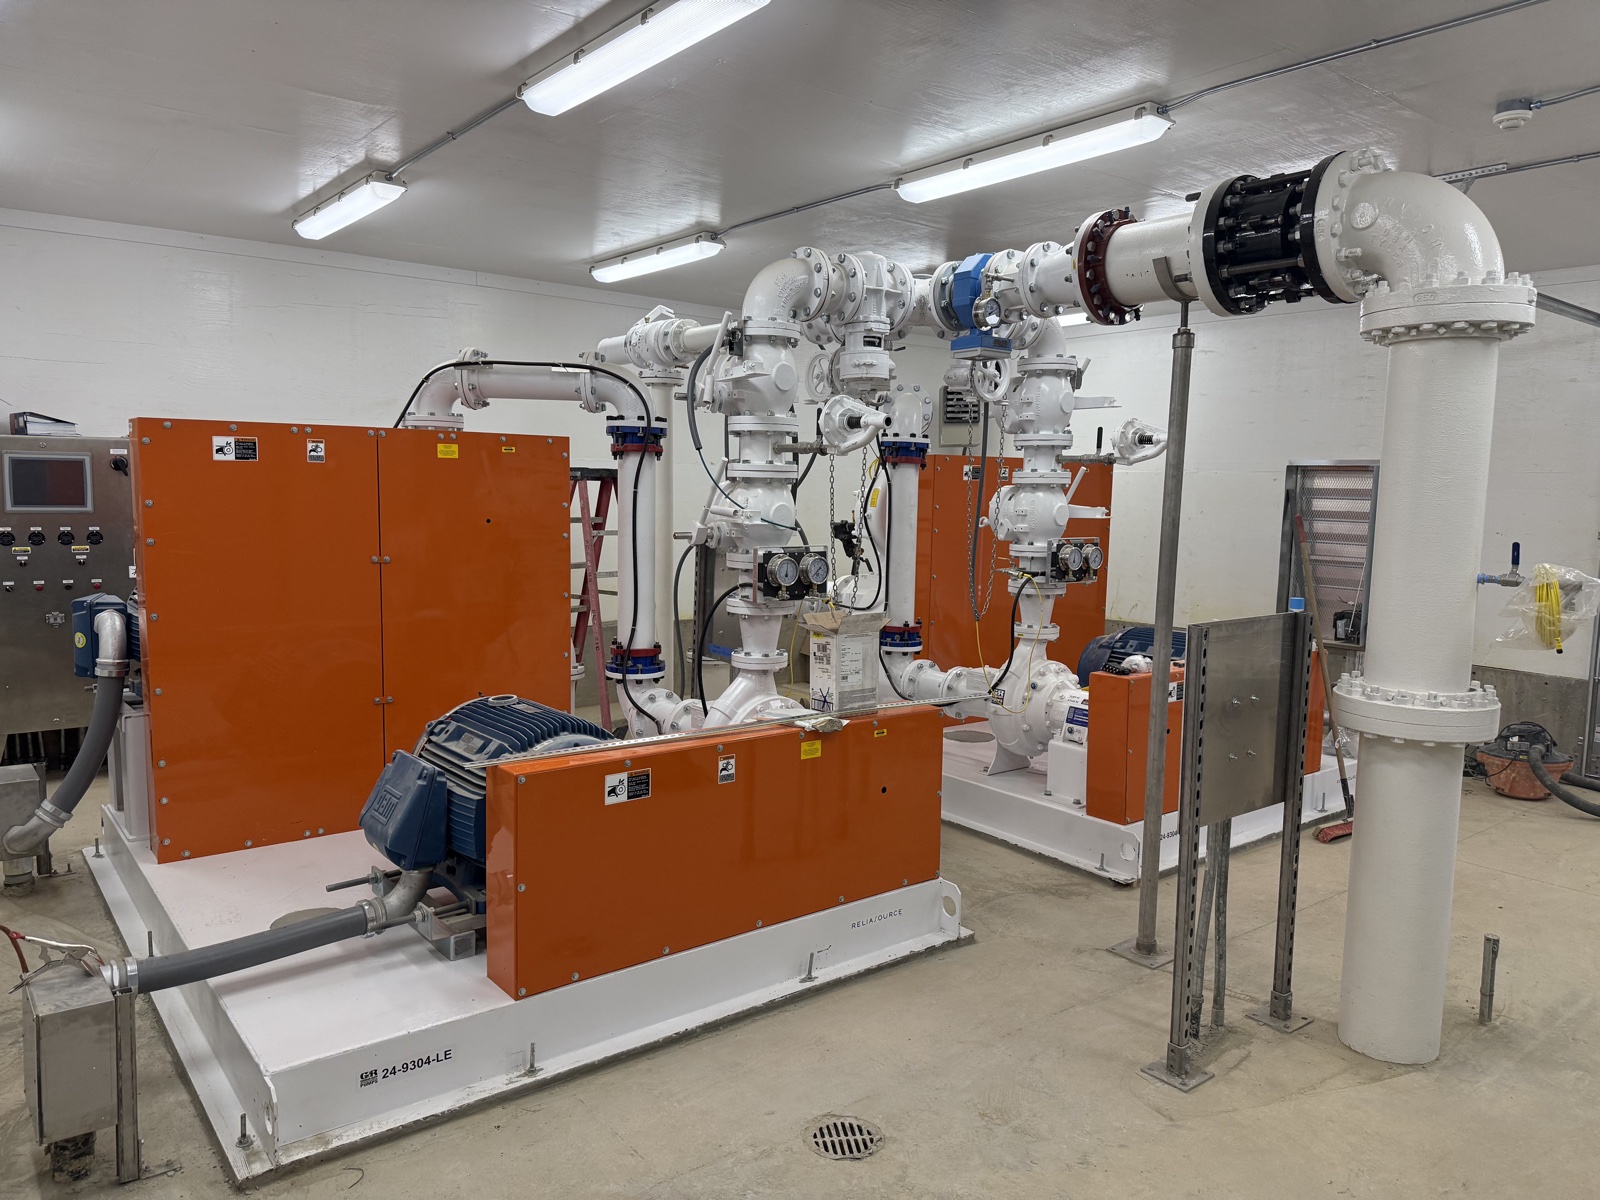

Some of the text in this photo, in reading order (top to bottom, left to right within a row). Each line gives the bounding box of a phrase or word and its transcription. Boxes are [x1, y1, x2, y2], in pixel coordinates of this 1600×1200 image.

[1414, 292, 1437, 301] 250
[1160, 830, 1179, 840] 24-9304
[851, 909, 903, 929] RELIASOURCE
[382, 1049, 452, 1079] 24-9304-LE
